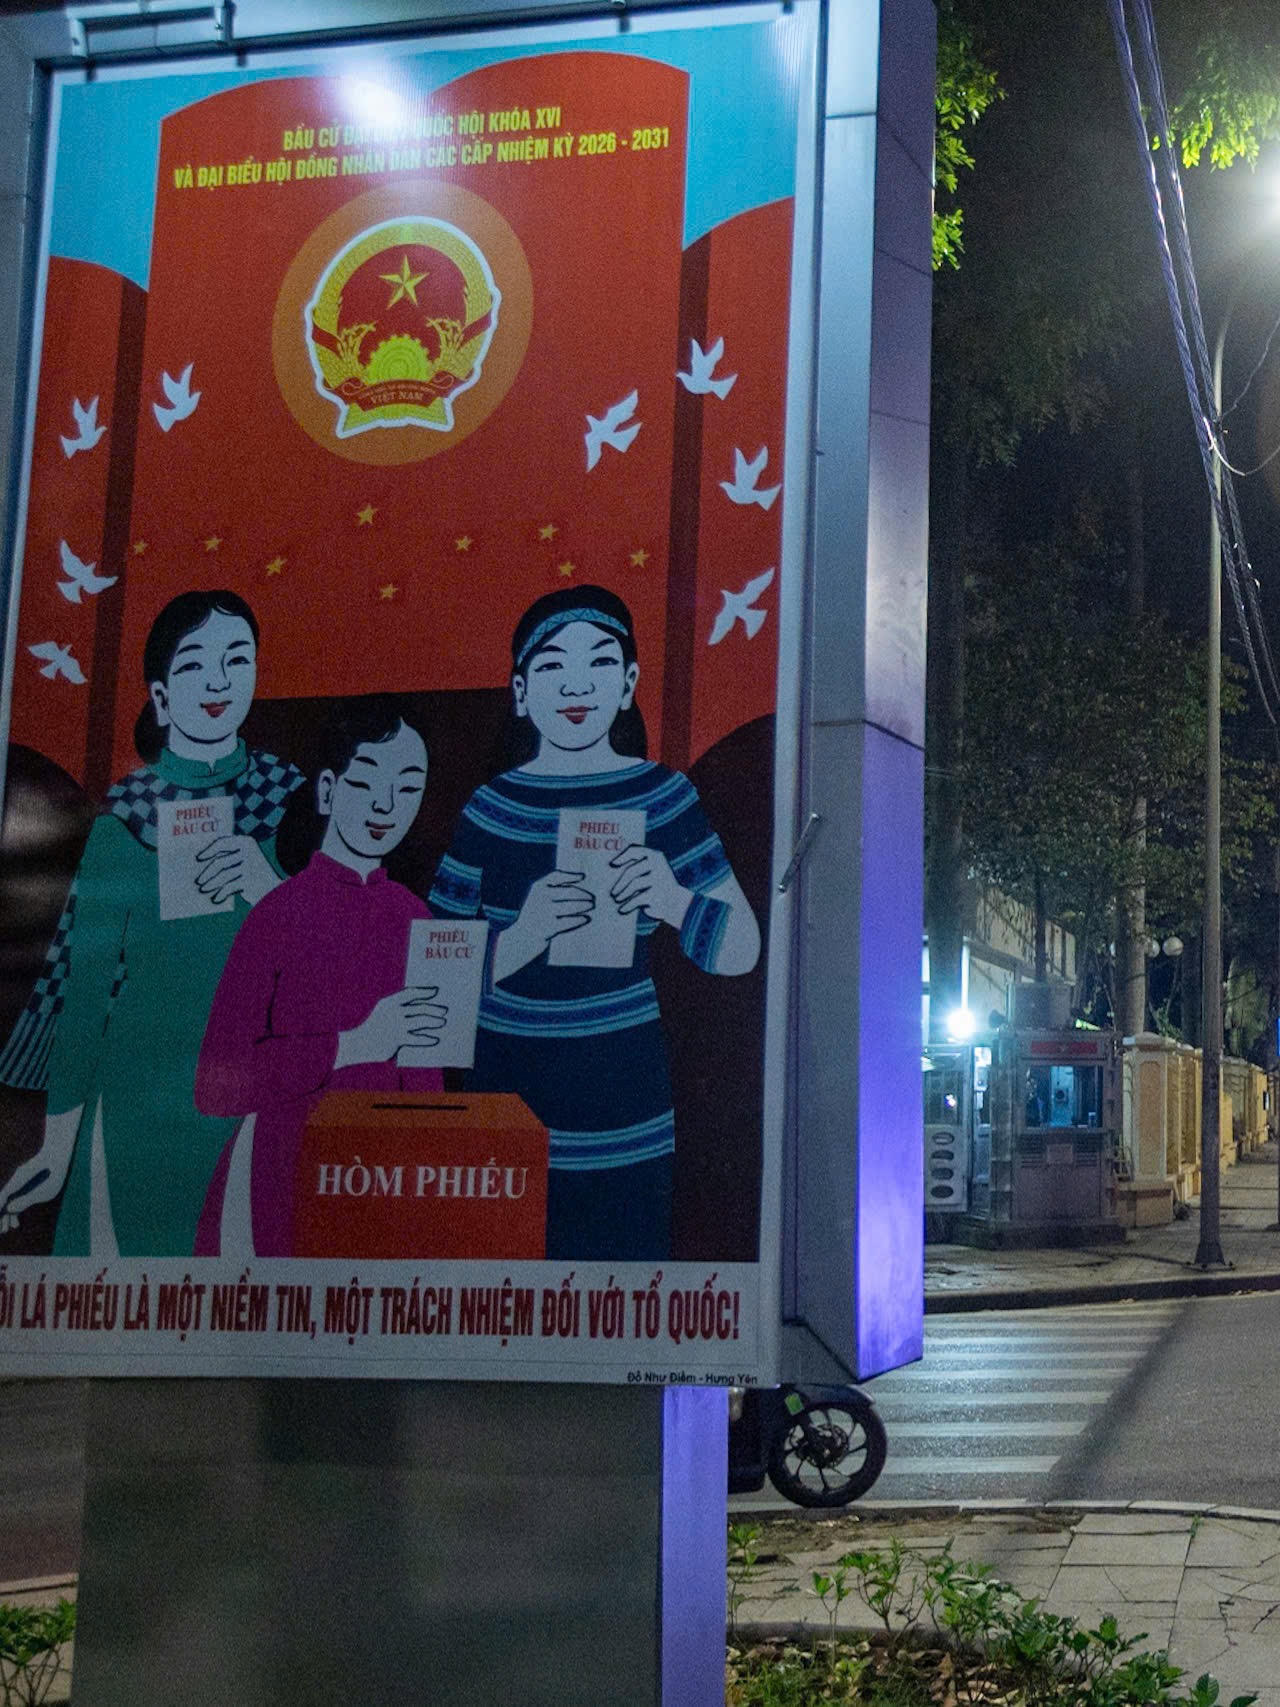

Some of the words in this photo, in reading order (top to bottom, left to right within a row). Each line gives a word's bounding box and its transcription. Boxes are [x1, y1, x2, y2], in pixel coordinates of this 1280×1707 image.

[283, 123, 314, 150] BẦU
[318, 119, 340, 148] CỬ
[458, 111, 485, 138] HỘI
[489, 106, 531, 133] KHÓA
[535, 107, 561, 129] XVI
[174, 163, 193, 189] VÀ
[197, 165, 224, 191] ĐẠI
[226, 155, 263, 184] BIỂU
[265, 157, 292, 186] HỘI
[295, 152, 338, 180] ĐỒNG
[461, 136, 493, 166] CẤP
[497, 135, 549, 165] NHIỆM
[553, 132, 574, 158] KỲ
[577, 132, 617, 156] 2026
[631, 127, 670, 151] 2031
[317, 1156, 403, 1197] HÒM
[415, 1157, 528, 1199] PHIẾU
[20, 1273, 46, 1329] LÁ
[53, 1267, 119, 1331] PHIẾU
[123, 1274, 149, 1331] LÀ
[156, 1274, 206, 1342] MỘT
[210, 1267, 270, 1332] NIỀM
[275, 1285, 317, 1339] TIN,
[323, 1276, 375, 1345] MỘT
[380, 1277, 453, 1335] TRÁCH
[458, 1277, 535, 1347] NHIỆM
[541, 1271, 580, 1338] ĐỐI
[588, 1275, 625, 1339] VỚI
[632, 1270, 663, 1339] TỔ
[668, 1272, 740, 1345] QUỐC!
